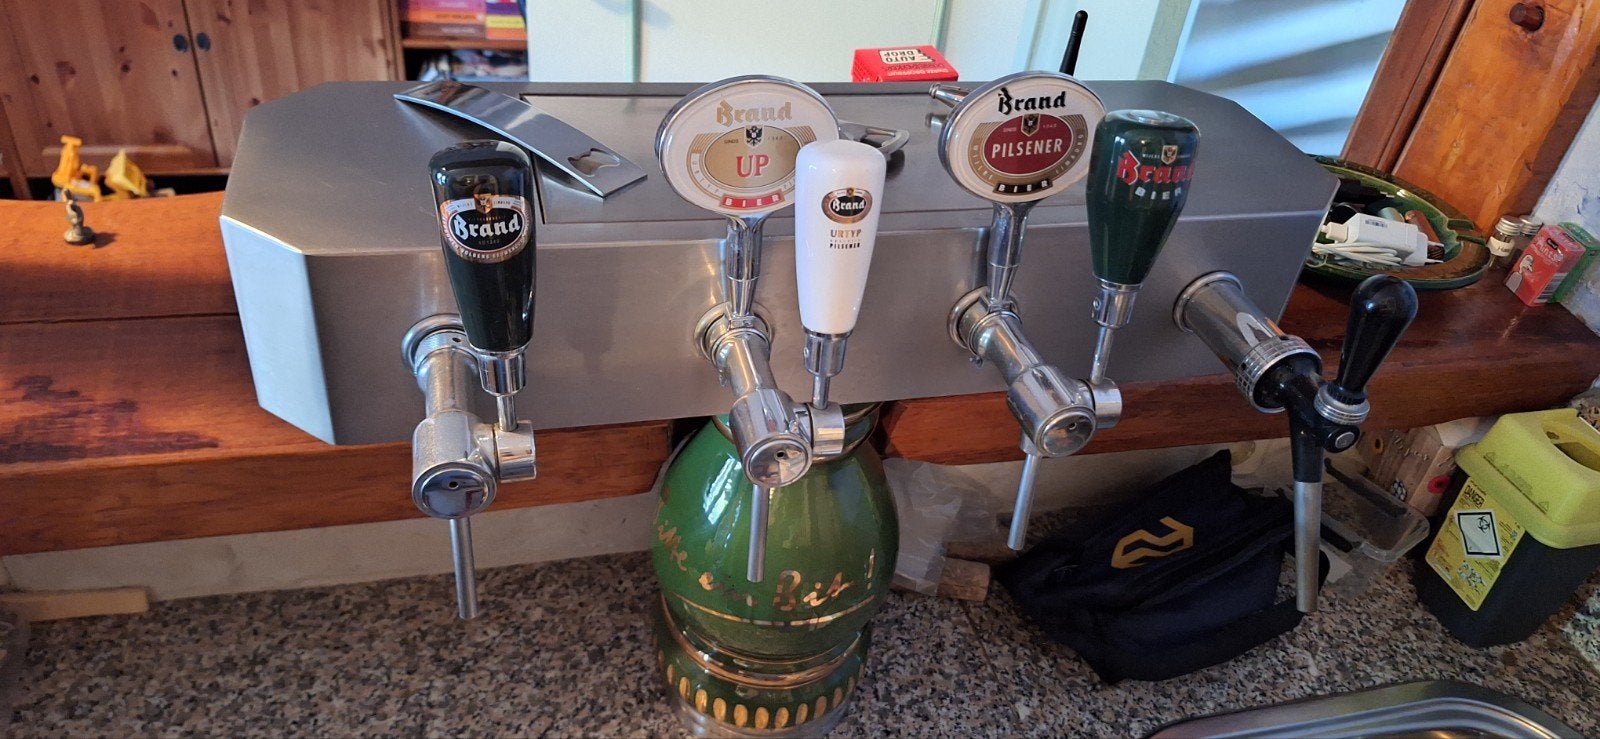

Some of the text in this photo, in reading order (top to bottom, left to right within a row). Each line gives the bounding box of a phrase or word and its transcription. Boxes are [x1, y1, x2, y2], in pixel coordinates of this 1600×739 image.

[998, 87, 1066, 115] Brand
[716, 100, 793, 128] Brand
[991, 138, 1063, 159] PILSENER
[736, 154, 769, 178] UP
[998, 180, 1048, 192] BIER
[725, 194, 780, 207] BIER
[832, 199, 865, 211] Brand
[453, 213, 520, 240] Brand
[830, 229, 861, 238] URTYP
